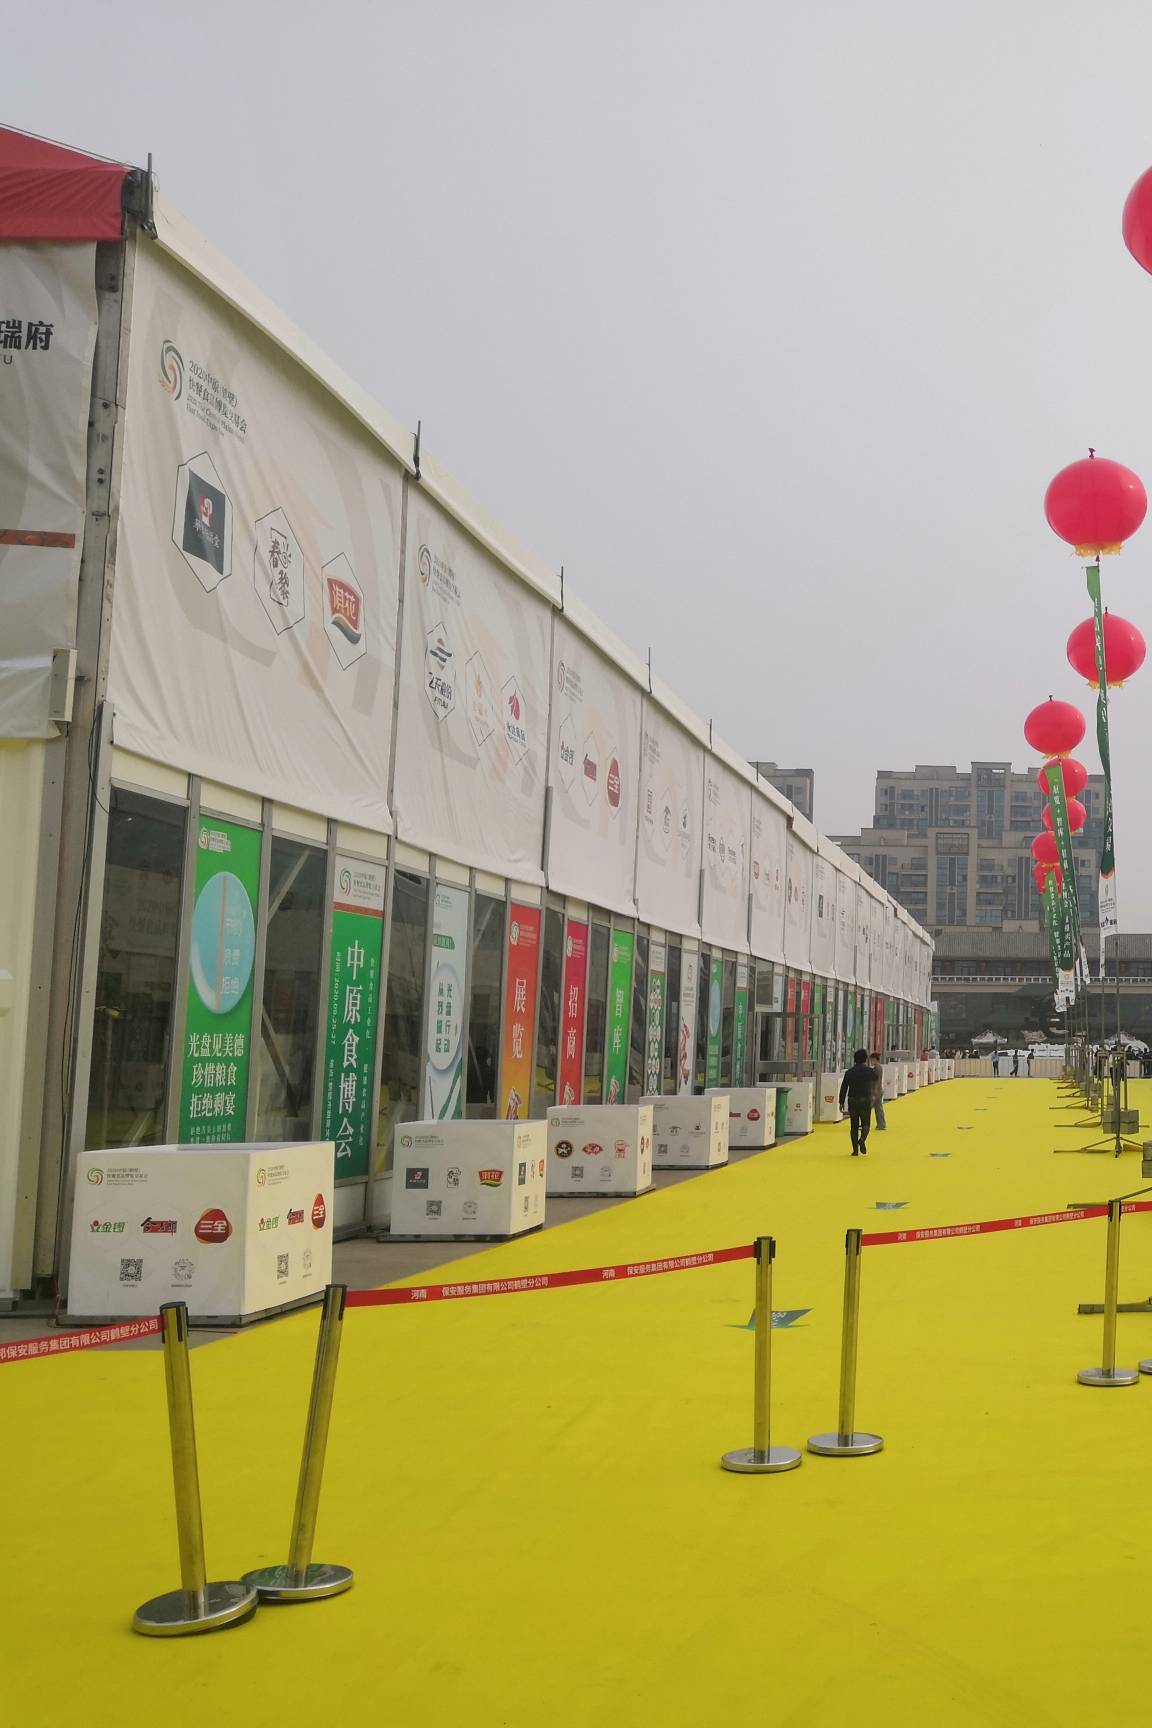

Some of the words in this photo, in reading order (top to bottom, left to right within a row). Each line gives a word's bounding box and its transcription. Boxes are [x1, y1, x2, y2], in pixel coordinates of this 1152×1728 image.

[0, 319, 54, 350] 瑞府
[511, 979, 527, 1058] 展览
[188, 1033, 245, 1058] 光盘见美德
[336, 940, 364, 1158] 中原食博会
[192, 1063, 237, 1088] 珍惜粮食
[199, 1221, 227, 1233] 三全
[411, 1289, 427, 1300] 河南
